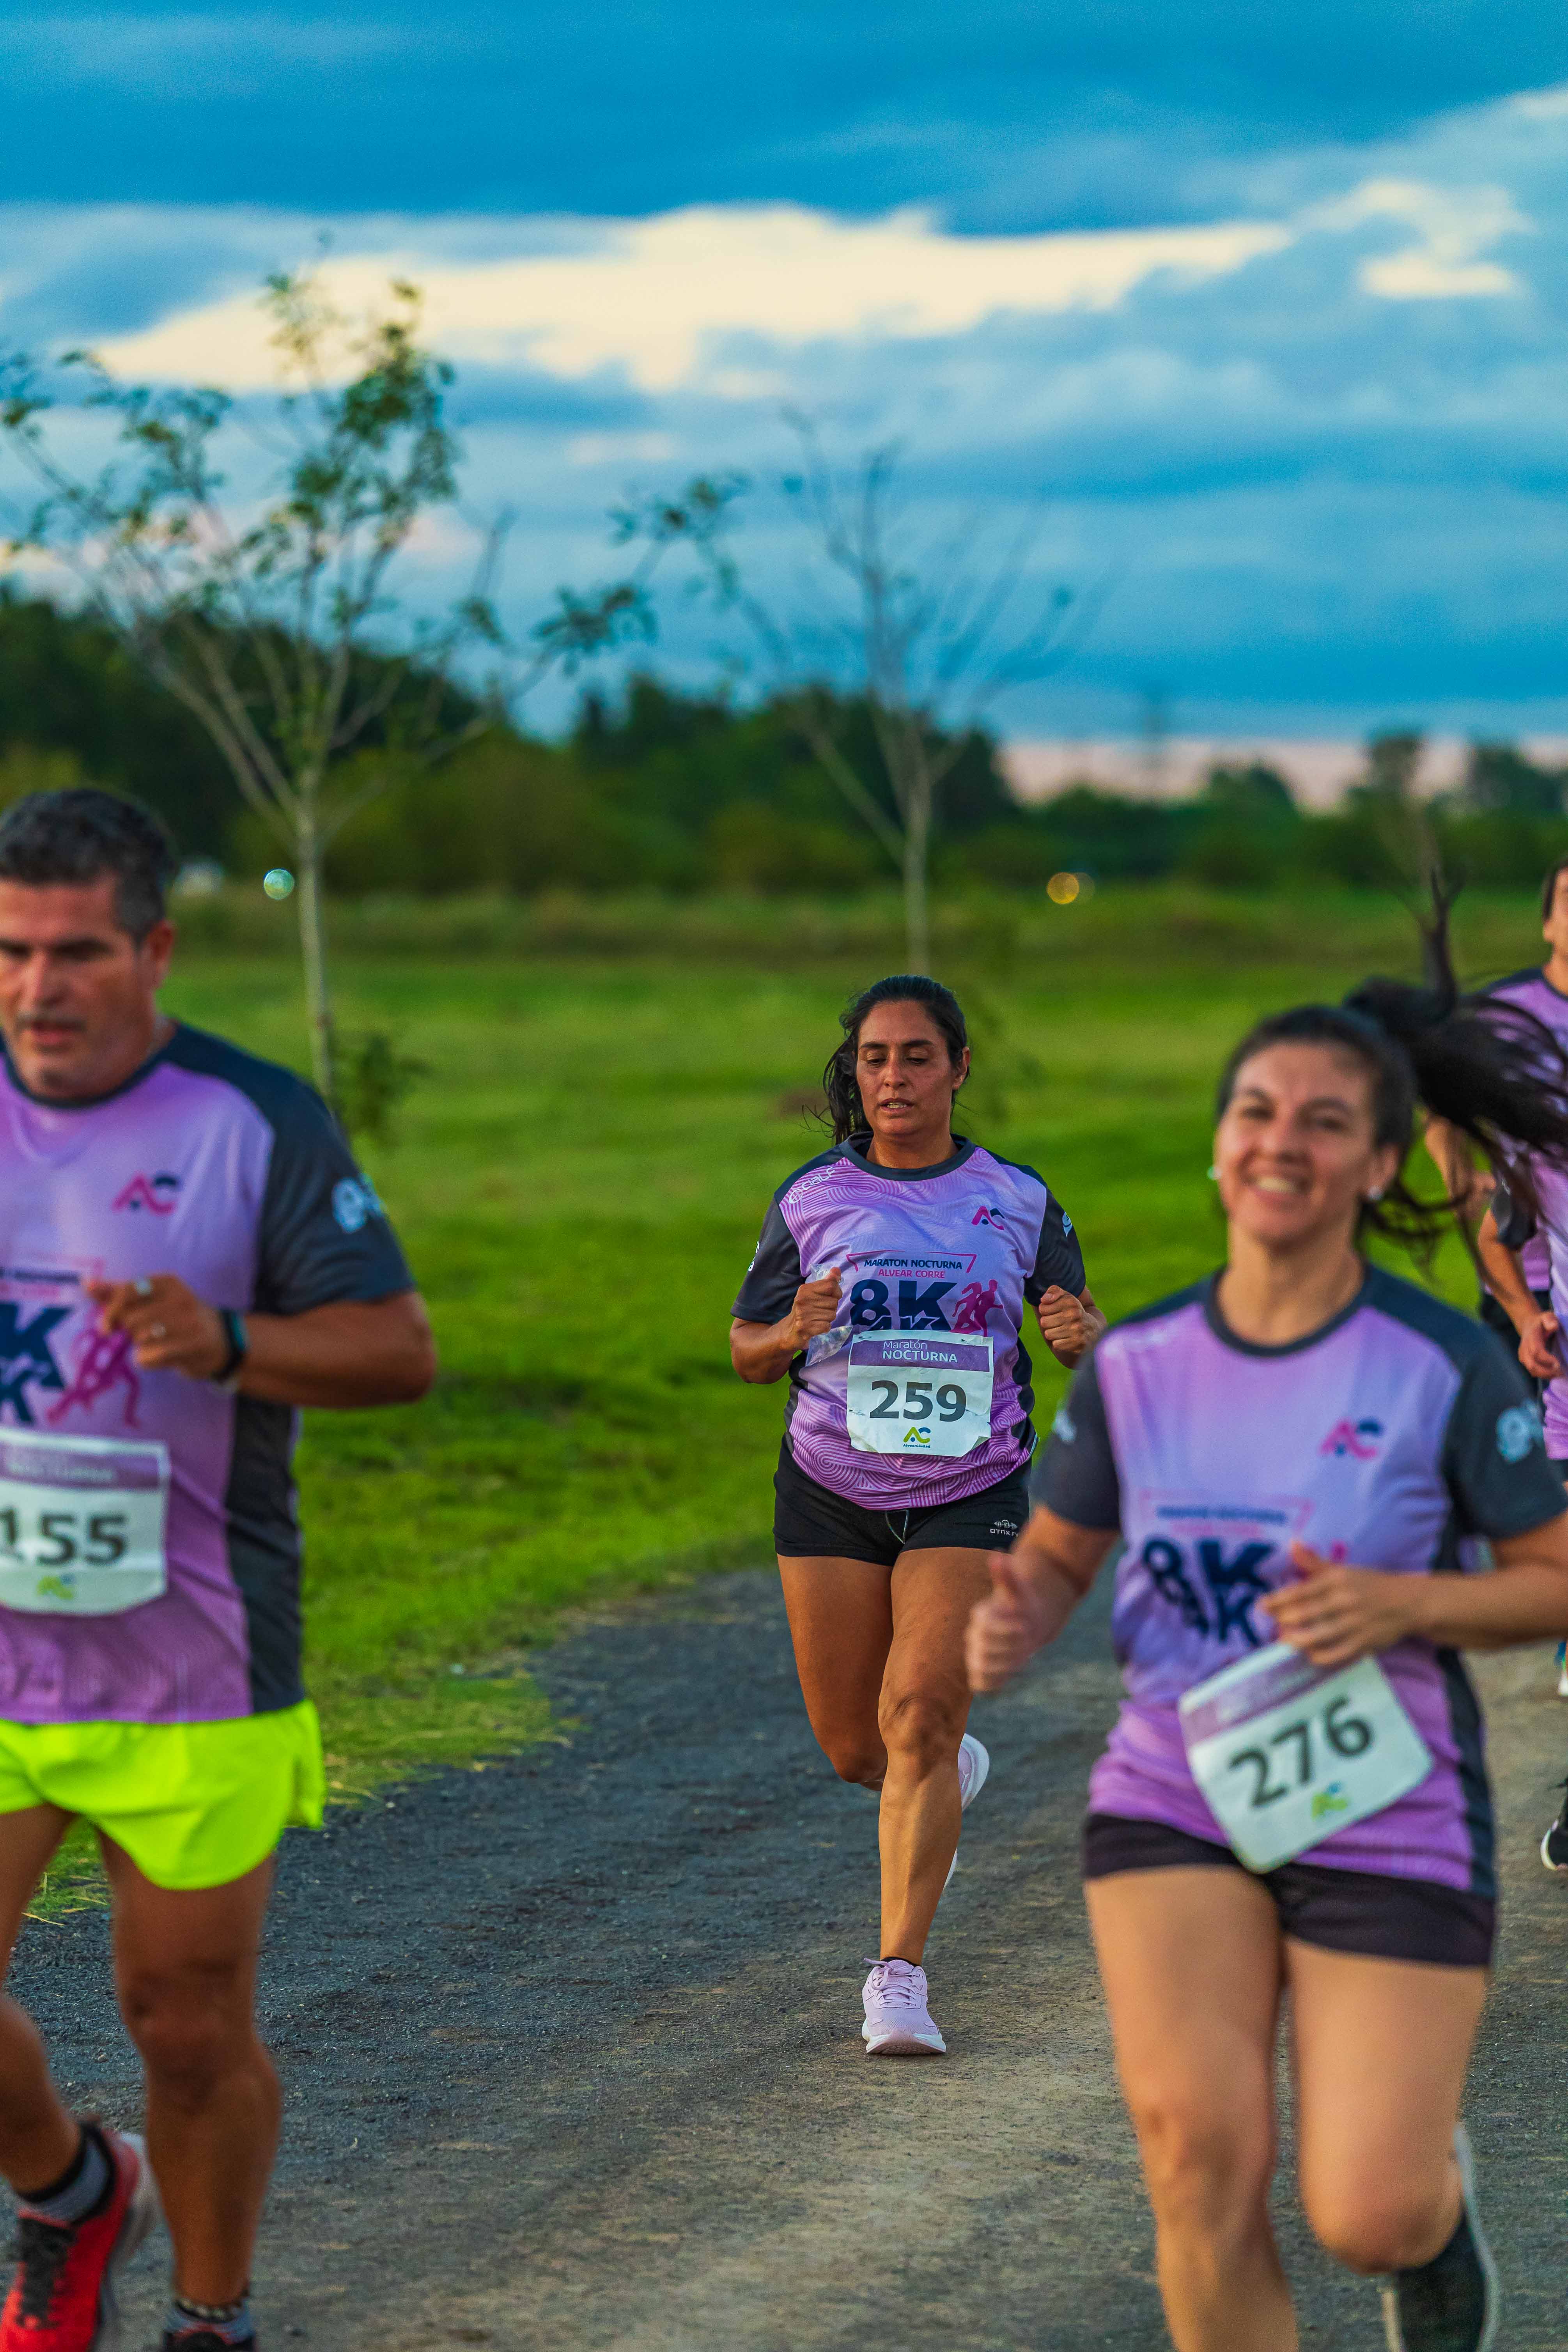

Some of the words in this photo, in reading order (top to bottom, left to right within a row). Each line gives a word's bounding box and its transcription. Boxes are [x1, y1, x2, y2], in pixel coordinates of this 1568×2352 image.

[864, 1259, 908, 1267] MARATON
[911, 1259, 962, 1270] NOCTURNA
[878, 1269, 912, 1277] ALVEAR
[915, 1270, 945, 1279] CORRE
[850, 1279, 958, 1330] 8K
[882, 1350, 958, 1363] NOCTURNA
[883, 1340, 927, 1350] Maratón
[869, 1380, 967, 1422] 259
[0, 1508, 128, 1565] 155
[1228, 1694, 1373, 1809] 276
